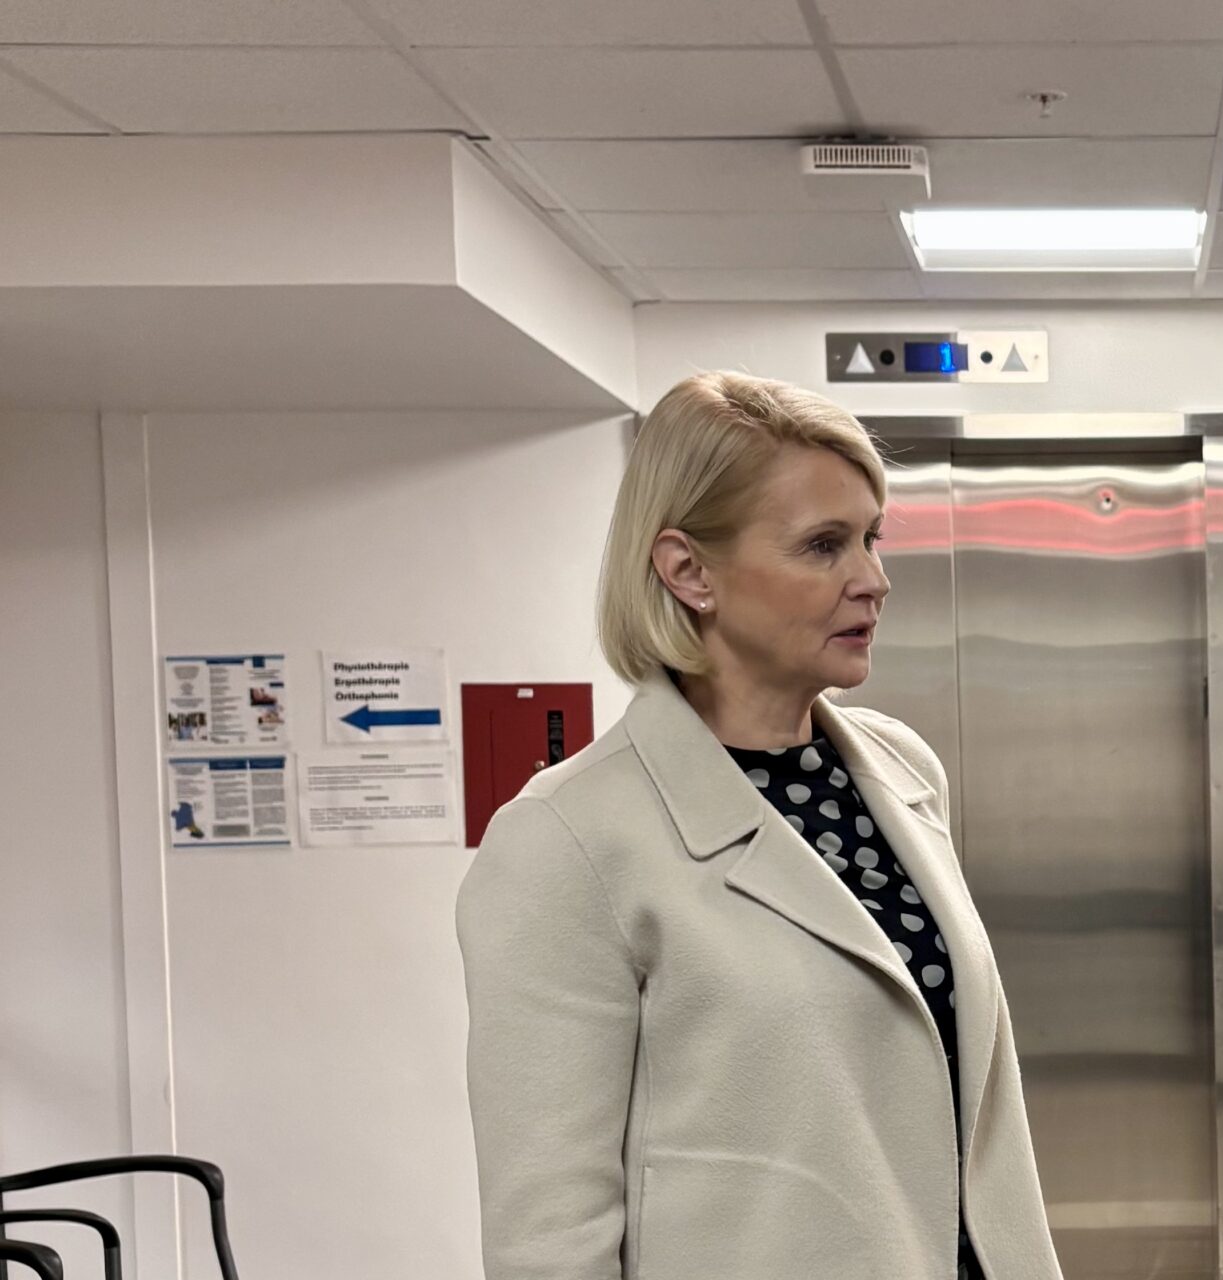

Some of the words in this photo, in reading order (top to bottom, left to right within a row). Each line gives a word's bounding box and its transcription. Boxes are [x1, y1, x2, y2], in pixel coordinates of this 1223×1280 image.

[939, 341, 955, 374] 1
[333, 661, 410, 673] Physiothérapie
[334, 677, 400, 688] Ergothérapie
[335, 691, 399, 702] Orthophonie
